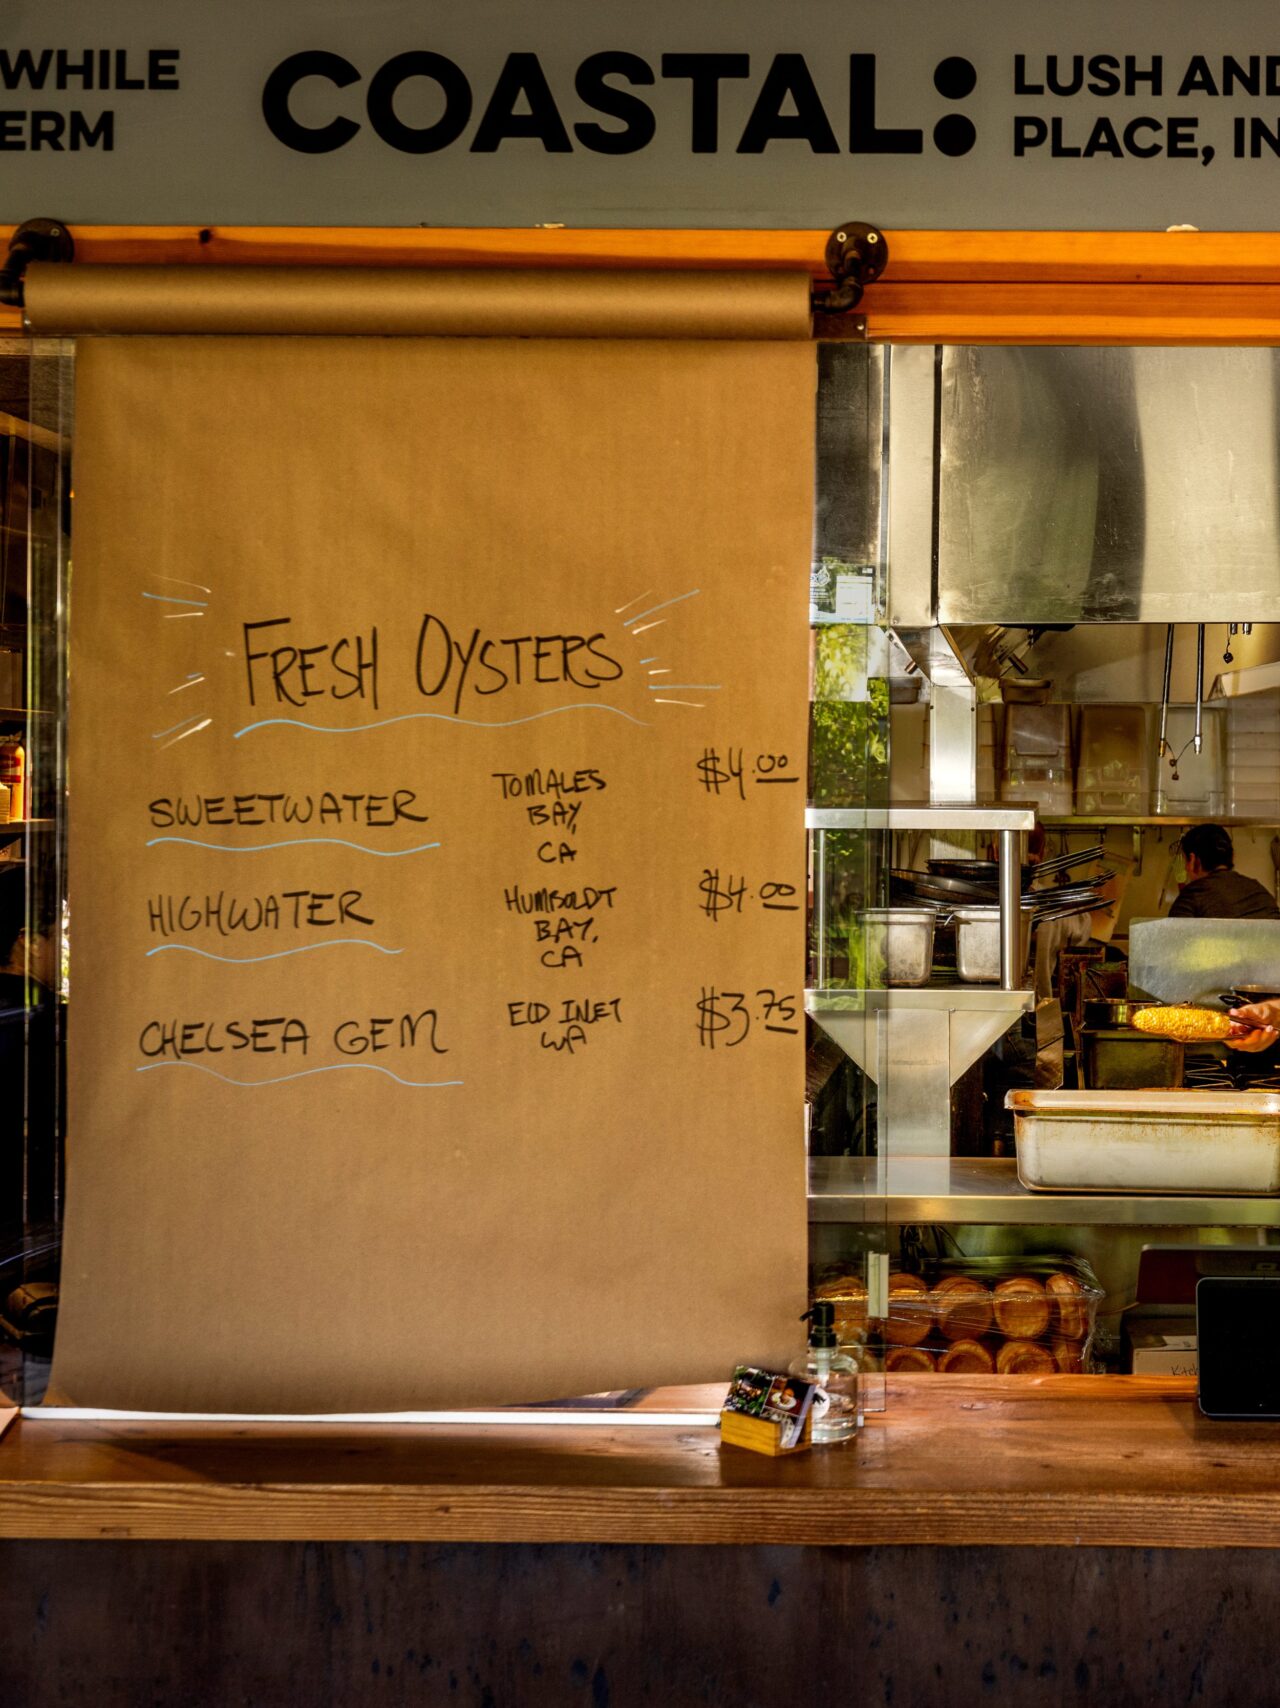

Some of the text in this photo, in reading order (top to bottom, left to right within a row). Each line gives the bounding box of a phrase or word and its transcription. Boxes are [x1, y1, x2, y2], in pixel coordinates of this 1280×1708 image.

[0, 49, 181, 91] WHILE
[1012, 54, 1164, 97] LUSH
[262, 50, 978, 157] COASTAL:
[0, 111, 115, 151] ERM
[1012, 116, 1215, 167] PLACE,
[243, 613, 624, 715] FRESH OYSTERS
[492, 768, 607, 799] TOMALES
[696, 747, 797, 800] $4.00
[148, 788, 430, 830] SWEETWATER
[527, 801, 582, 835] BAY,
[537, 841, 577, 864] CA
[148, 889, 375, 938] HIGHWATER
[504, 885, 617, 914] HUMBOLDT
[699, 868, 797, 922] $4.00
[534, 917, 599, 944] BAY,
[540, 945, 584, 968] CA
[139, 1008, 449, 1058] CHELSEA GEM
[695, 985, 797, 1050] $3.75
